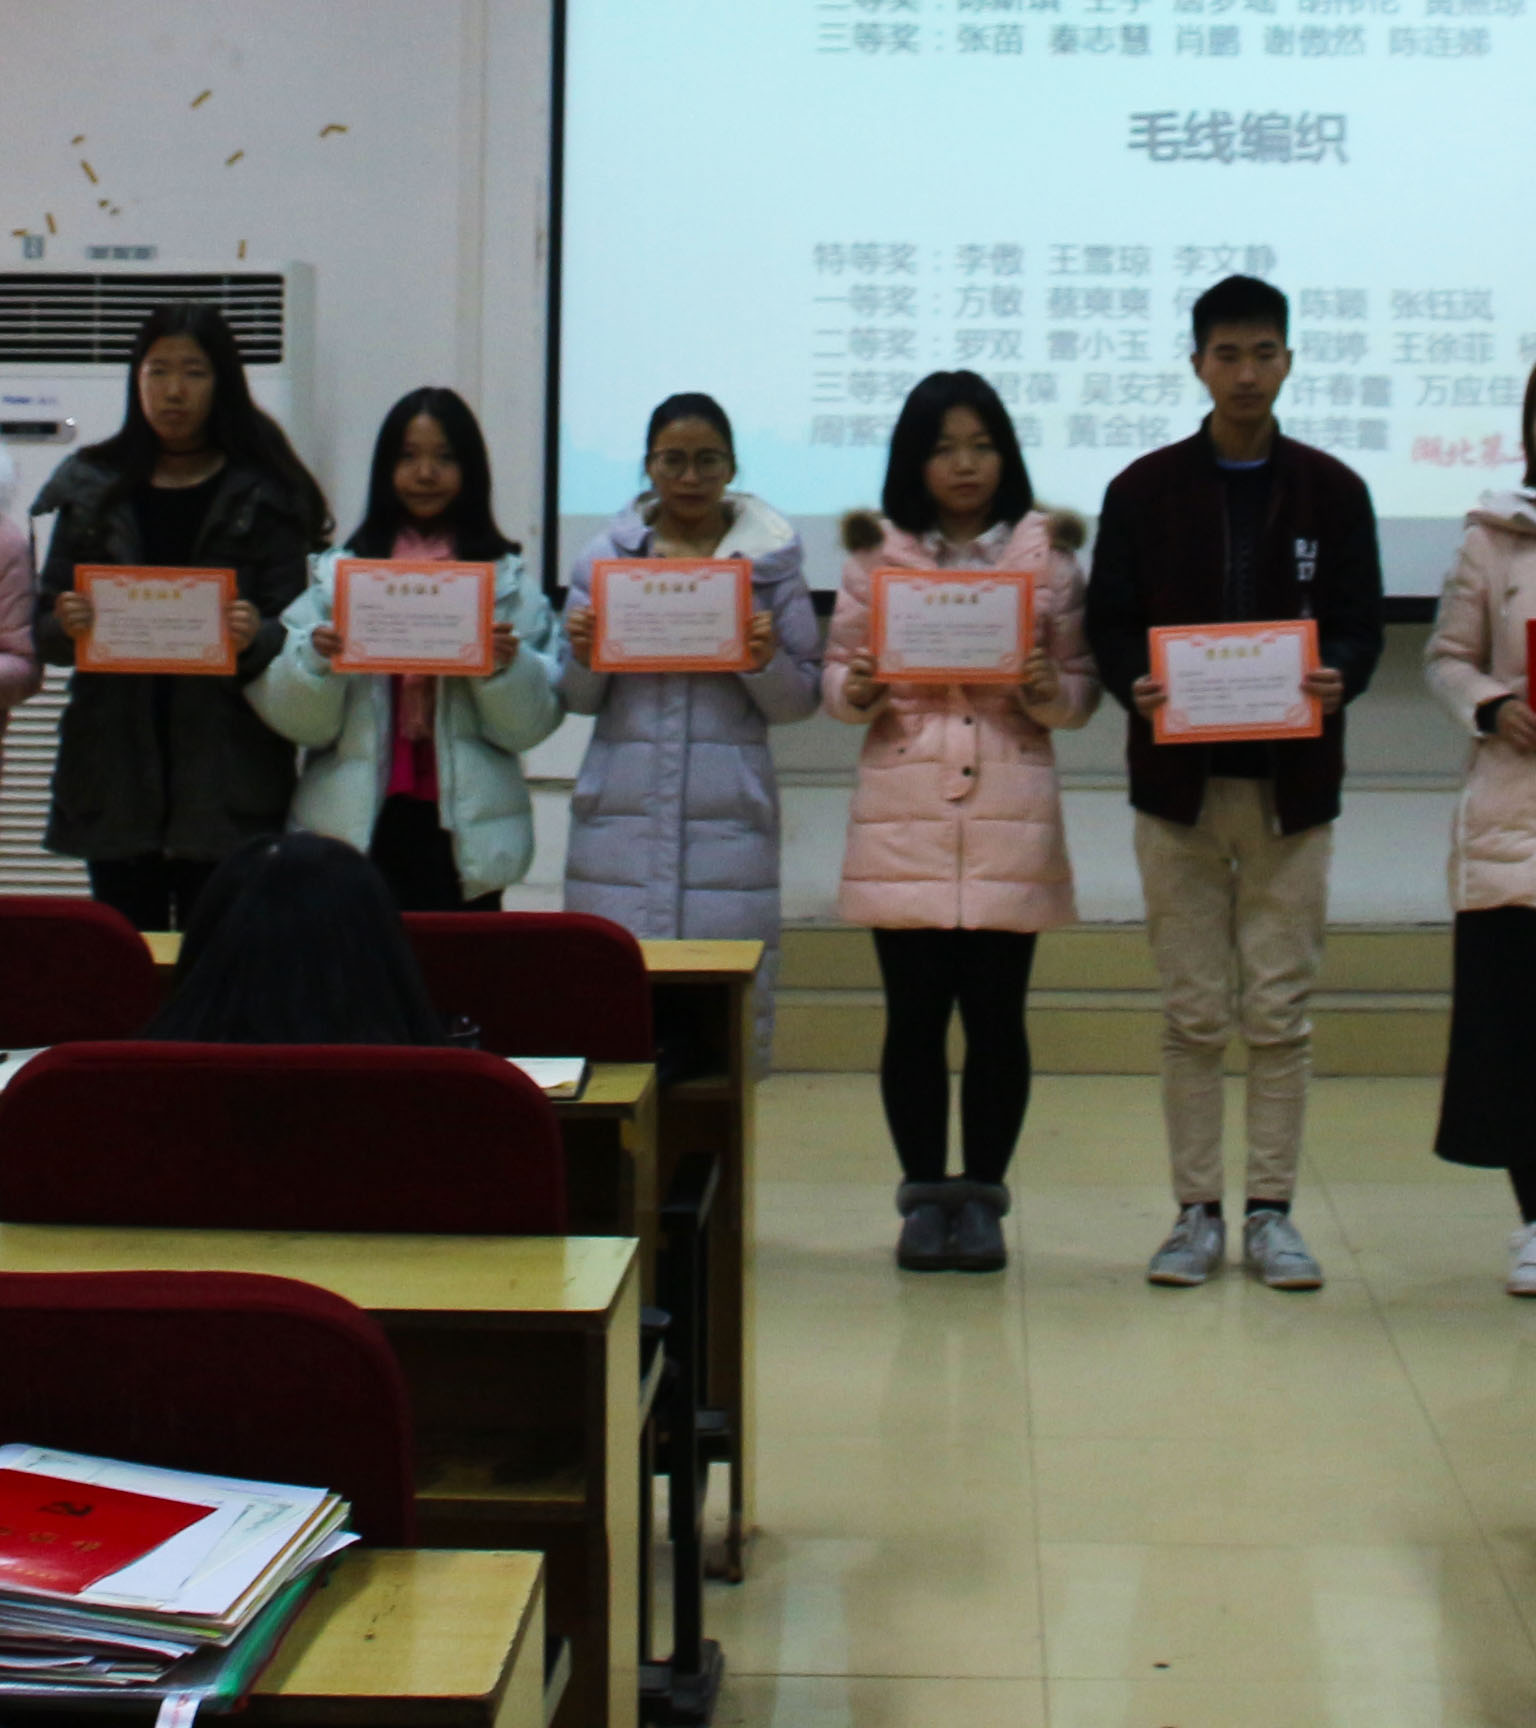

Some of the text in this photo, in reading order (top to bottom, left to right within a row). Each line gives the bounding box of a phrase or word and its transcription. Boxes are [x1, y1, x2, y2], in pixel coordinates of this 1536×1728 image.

[815, 23, 1024, 55] 三等奖：张苗
[1127, 110, 1349, 163] 毛线编织
[1173, 244, 1277, 276] 李文静
[812, 284, 1024, 320] 一等奖：方敏
[812, 327, 1024, 363] 二等奖：罗双
